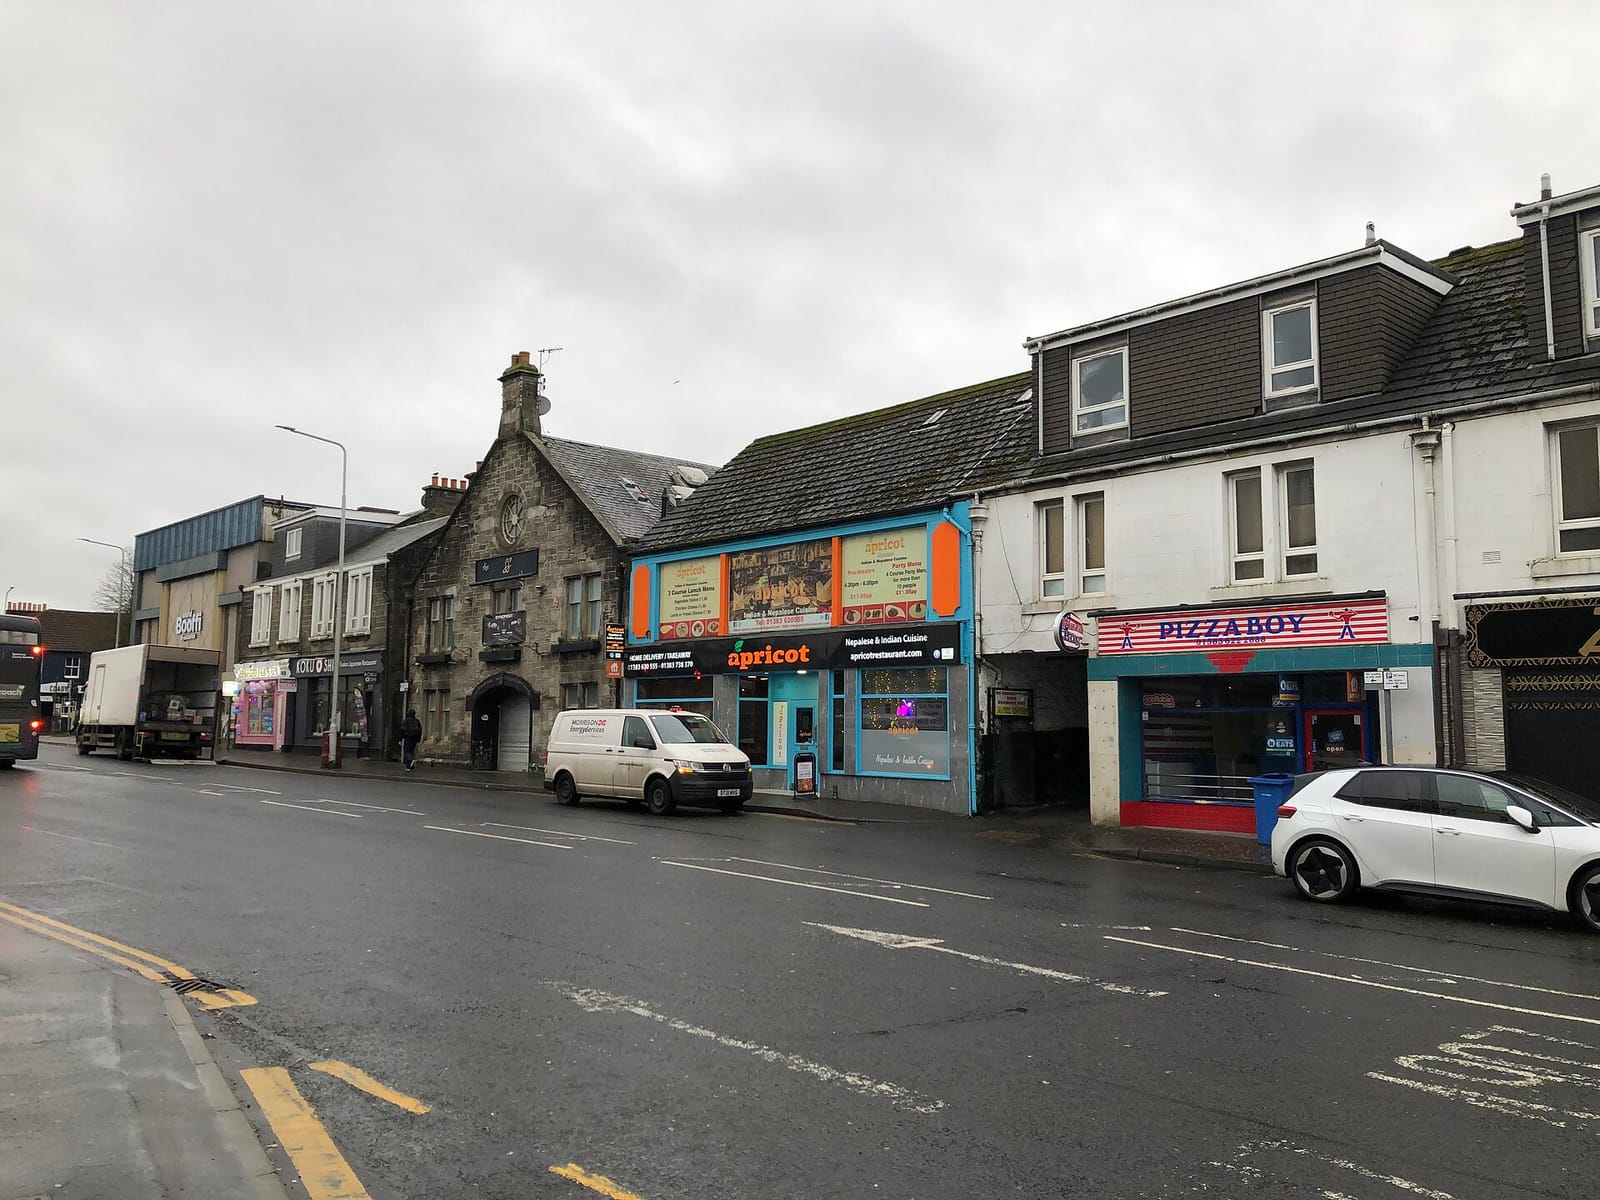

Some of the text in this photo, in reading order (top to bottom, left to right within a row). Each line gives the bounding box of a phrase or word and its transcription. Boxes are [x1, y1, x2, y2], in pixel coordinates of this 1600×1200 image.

[865, 538, 905, 555] apricot
[1160, 614, 1306, 640] PIZZA BOY
[845, 638, 874, 647] Nepalese
[881, 635, 902, 644] Indian
[903, 633, 928, 642] Cuisine
[643, 652, 664, 660] DELIVERY
[728, 645, 809, 670] apricot
[850, 650, 922, 661] apricotrestaurant.com
[296, 660, 314, 673] KOKU
